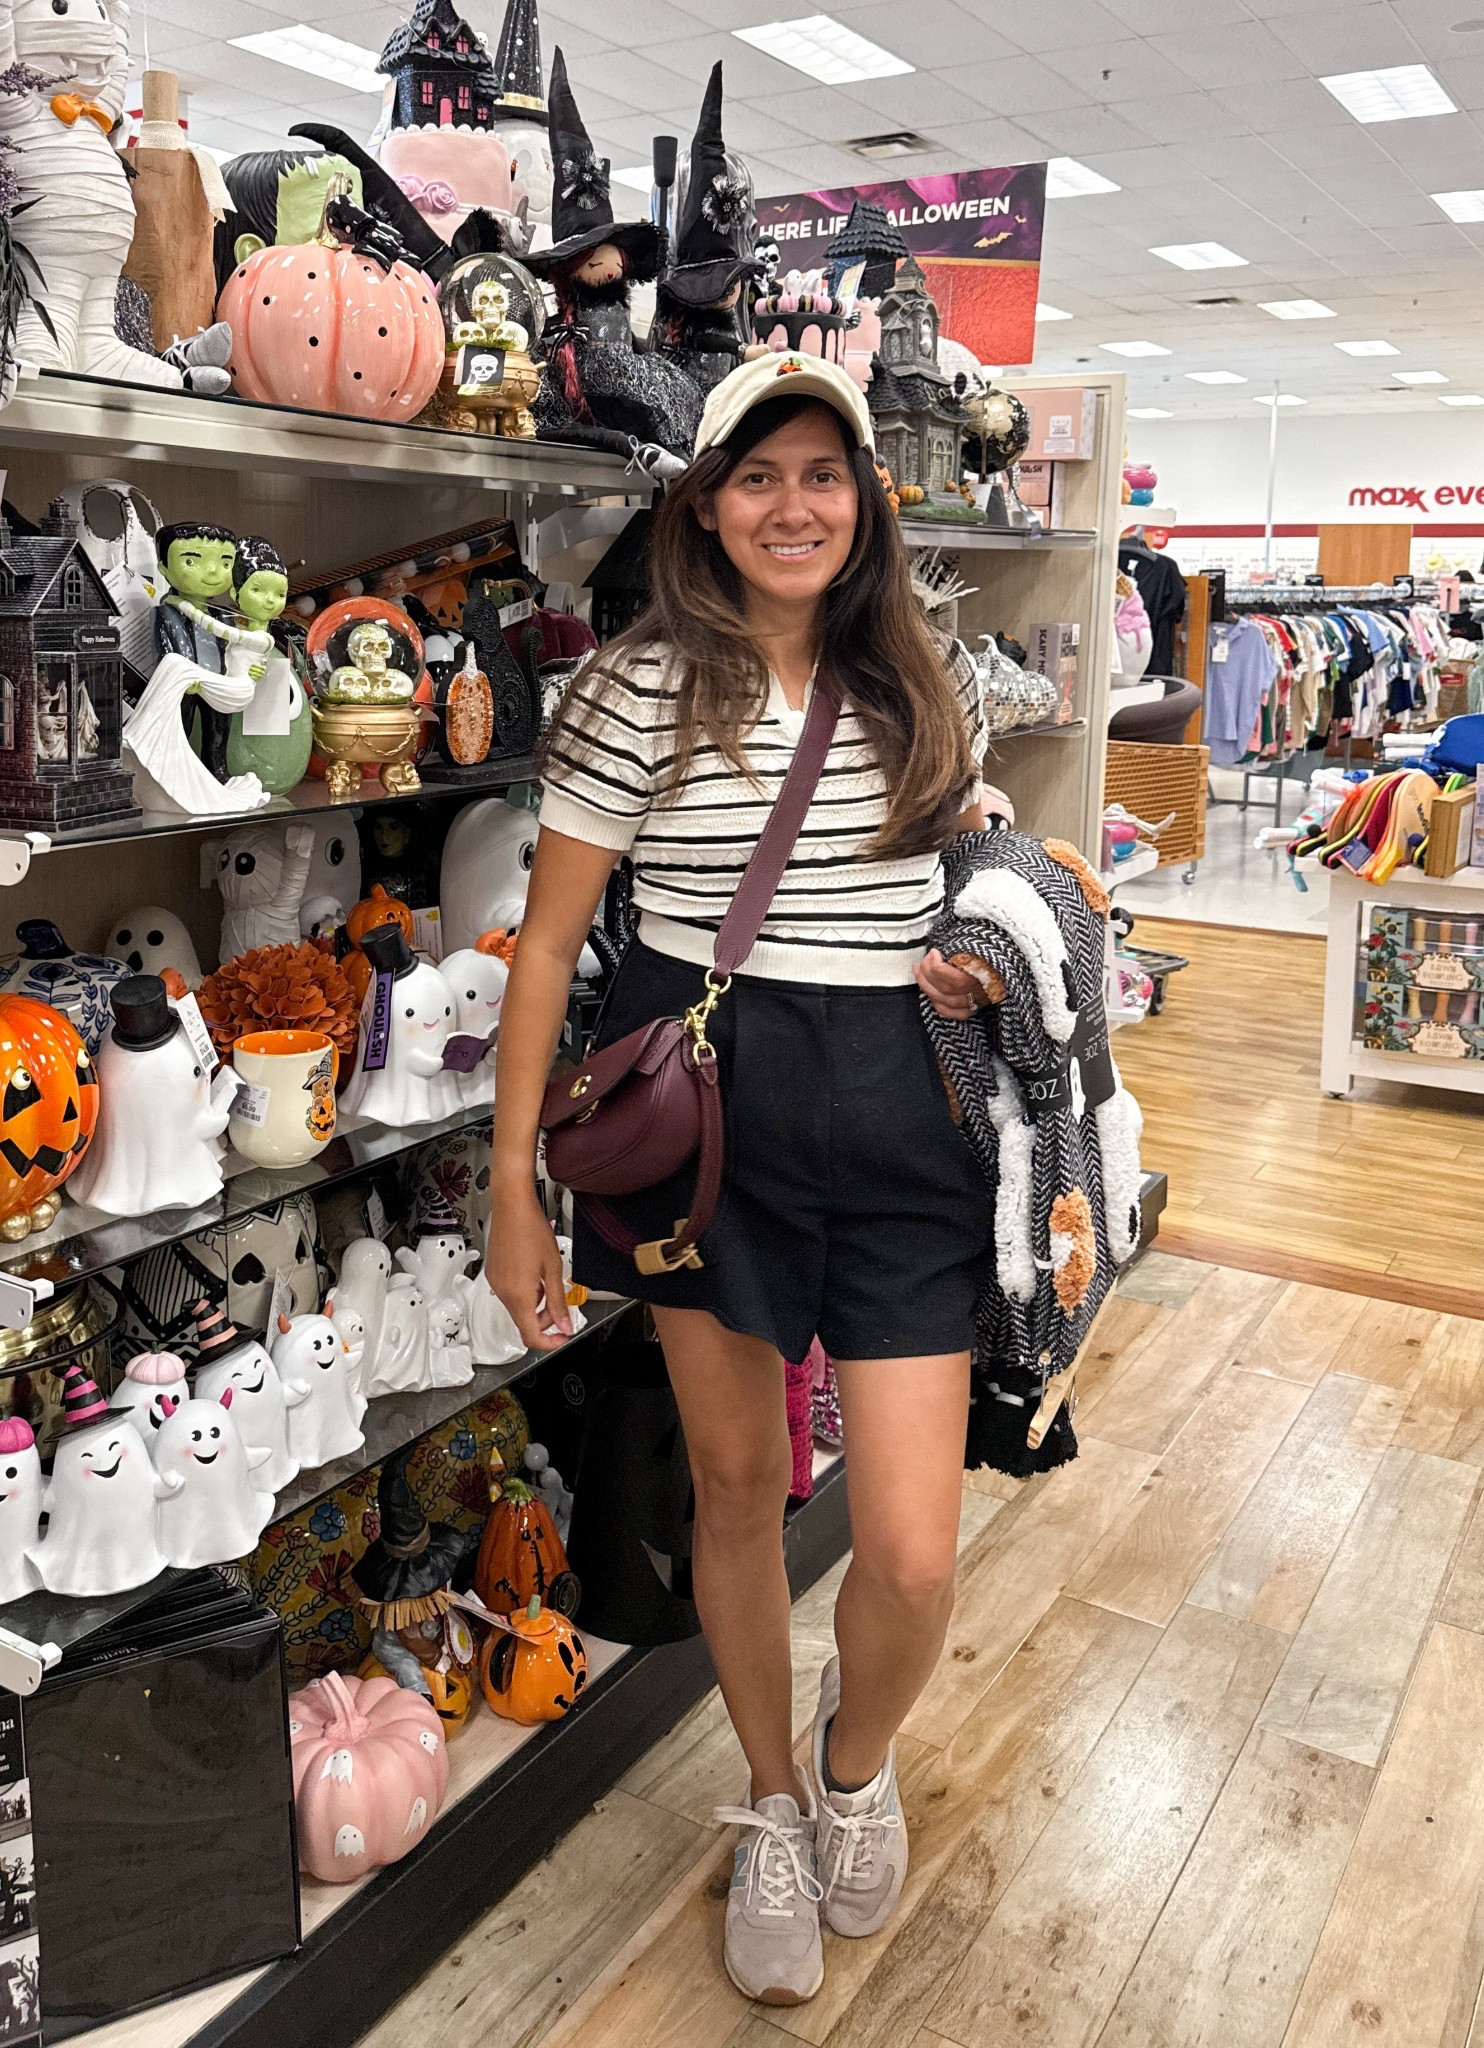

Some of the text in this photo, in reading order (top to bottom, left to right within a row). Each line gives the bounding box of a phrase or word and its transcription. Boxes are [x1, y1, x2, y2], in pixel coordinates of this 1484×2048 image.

[759, 195, 1011, 241] HERE LIE ALLOWEEN
[1348, 486, 1430, 513] maxx
[81, 635, 116, 644] Happy Halloween
[1037, 628, 1047, 657] SCARY
[369, 981, 386, 1059] GHOULISH
[1083, 1042, 1099, 1062] ZOE
[1026, 1078, 1062, 1101] ZOE
